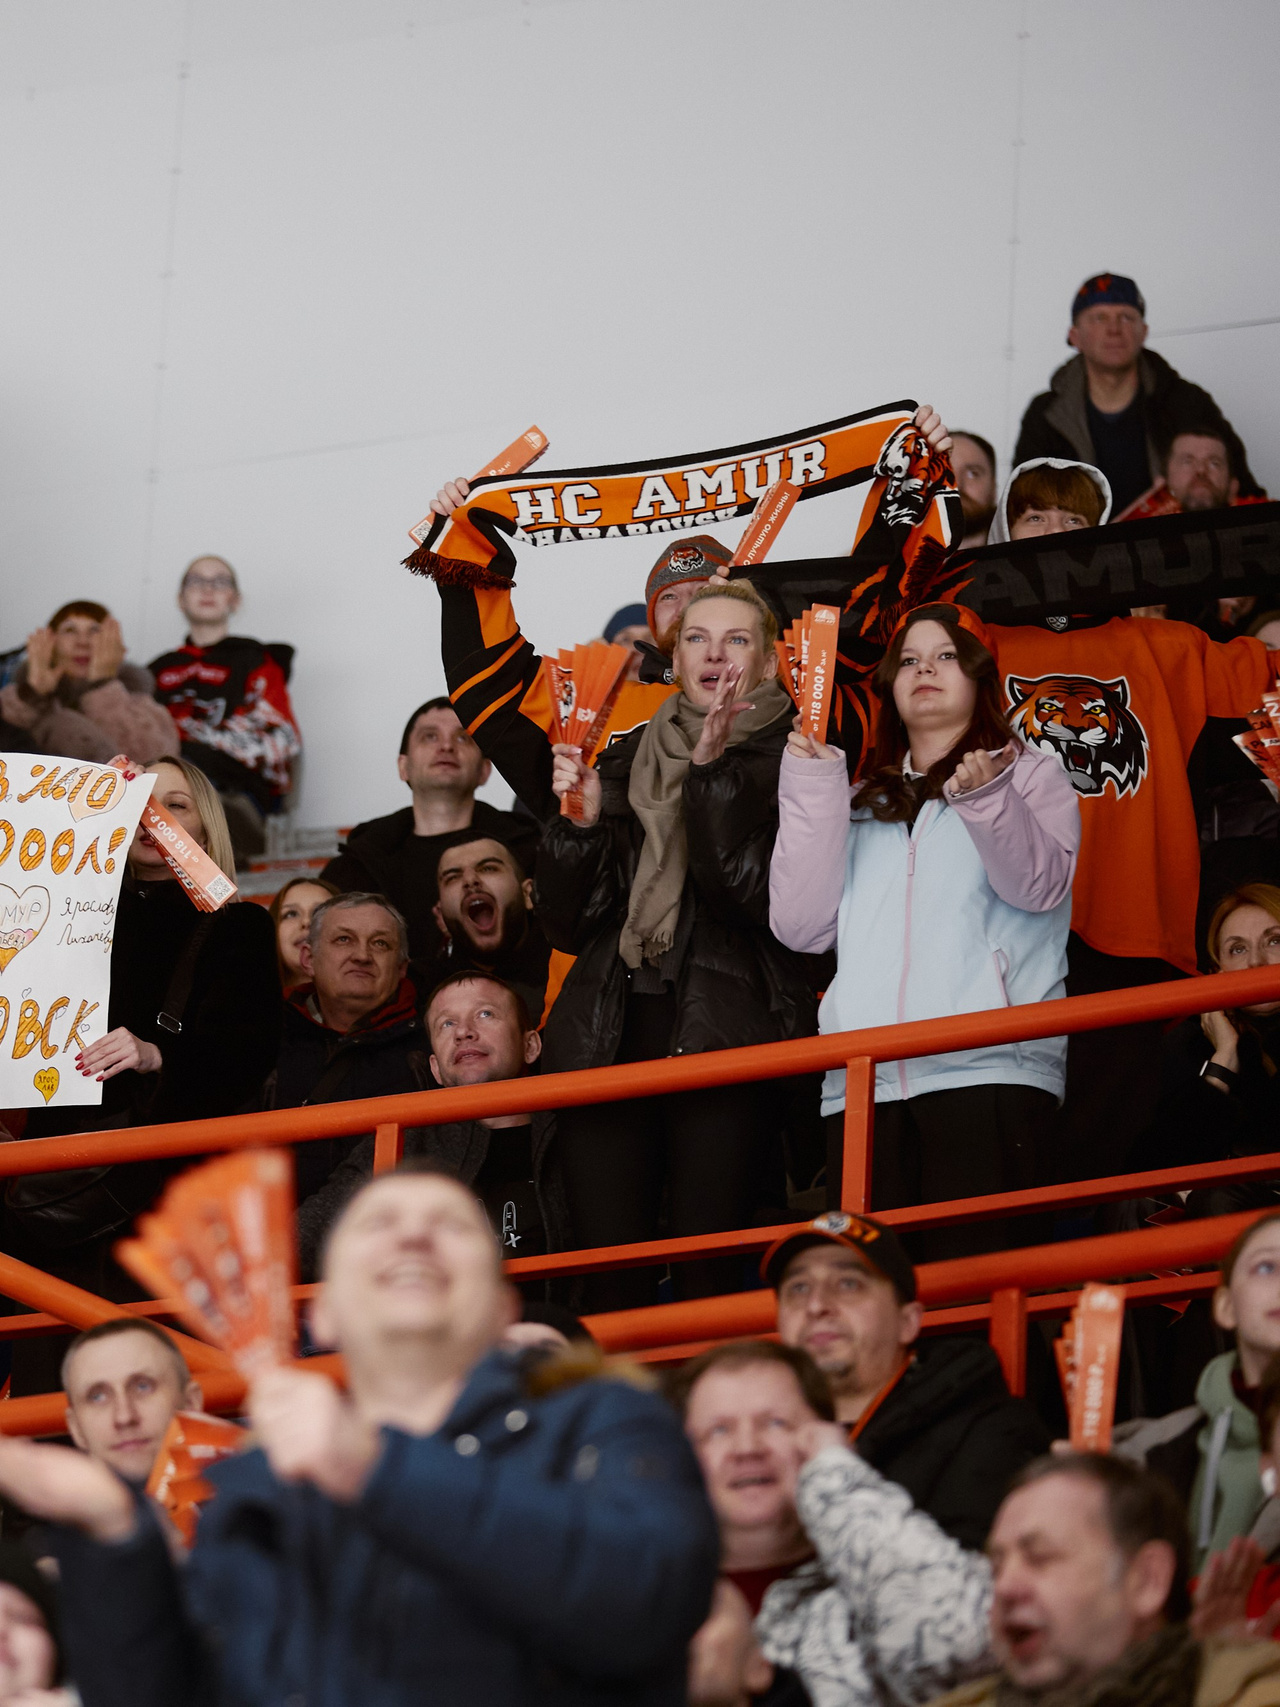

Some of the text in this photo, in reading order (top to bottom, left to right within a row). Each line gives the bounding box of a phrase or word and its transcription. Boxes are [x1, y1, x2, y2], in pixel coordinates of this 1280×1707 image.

[509, 440, 828, 529] HC AMUR
[749, 523, 772, 560] ЛУЧШУЮ
[770, 492, 790, 524] ЖИЗНЬ!
[812, 675, 825, 699] 000
[810, 702, 822, 722] 118
[156, 821, 178, 843] 000
[174, 840, 192, 860] 118
